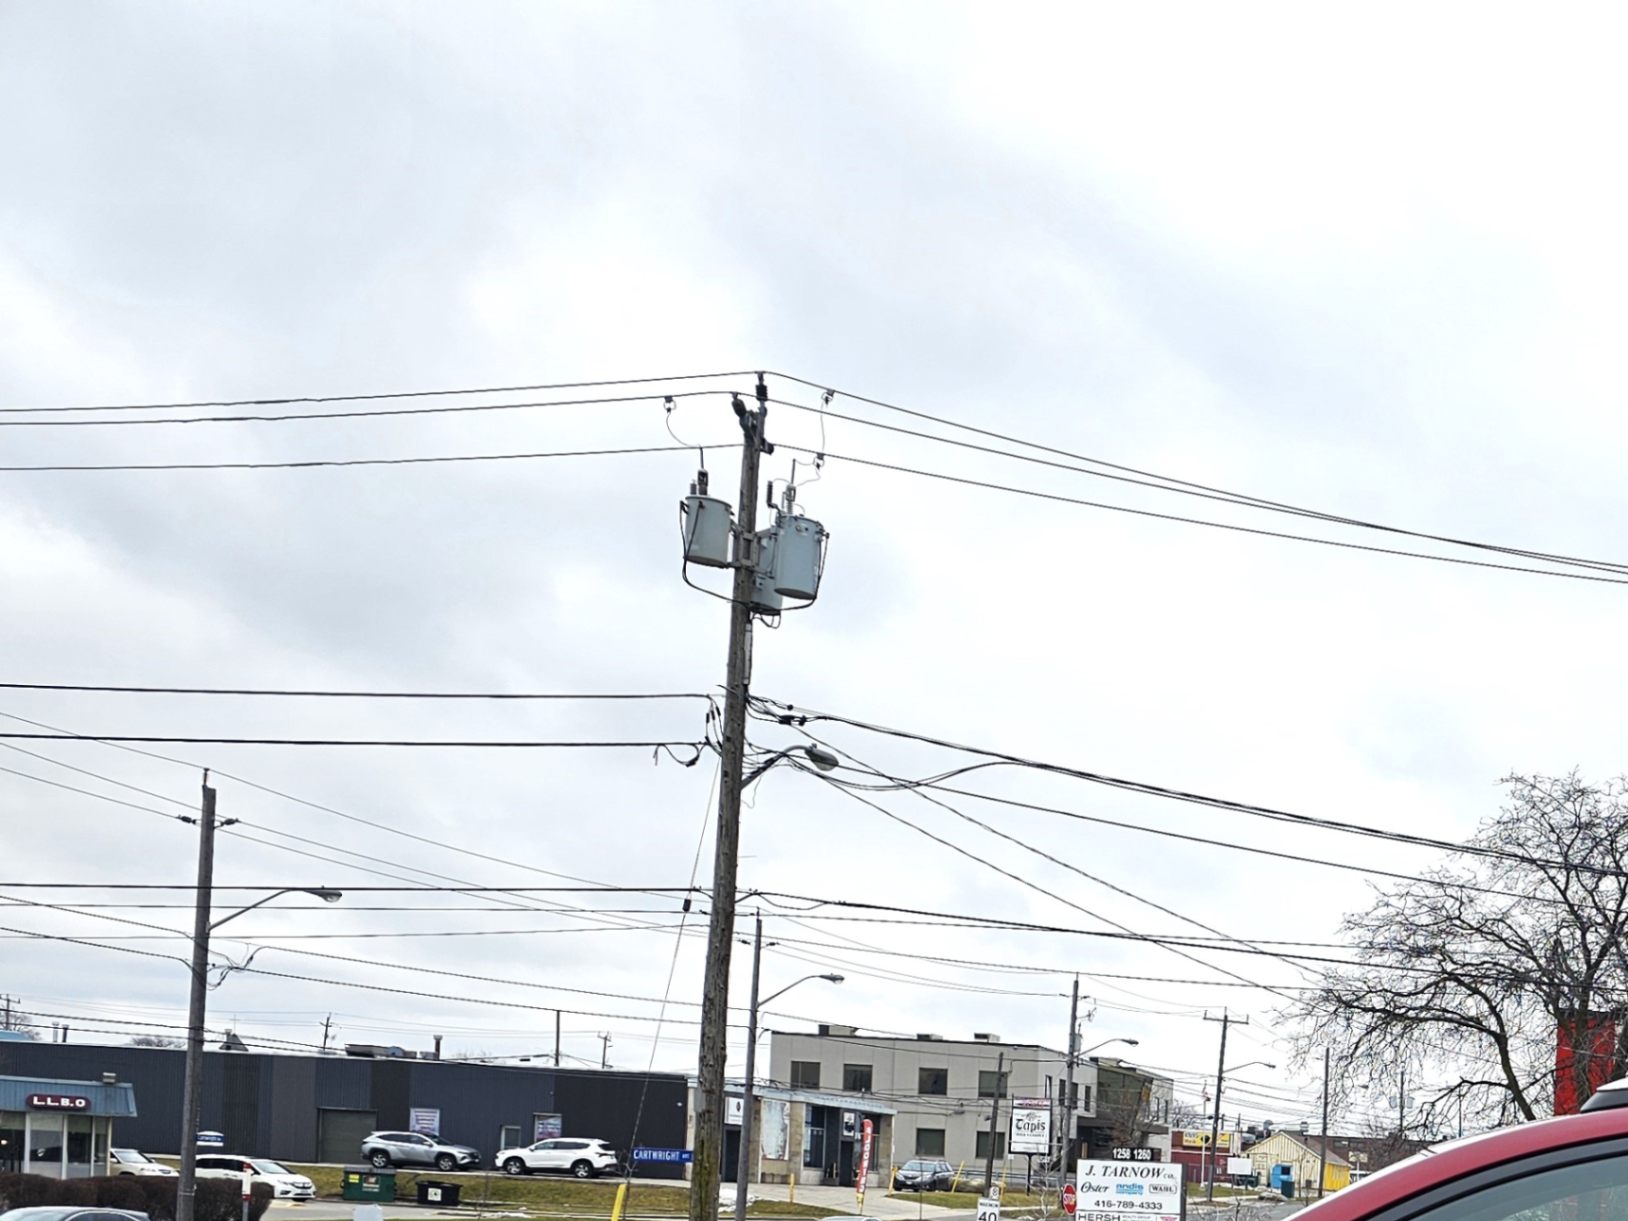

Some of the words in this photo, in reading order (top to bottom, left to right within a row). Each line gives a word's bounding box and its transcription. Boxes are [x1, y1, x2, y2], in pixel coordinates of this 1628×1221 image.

[1015, 1118, 1046, 1133] Tapis
[633, 1149, 680, 1161] CARTWRIGHT
[1112, 1148, 1131, 1159] 1258
[1085, 1165, 1096, 1177] J.
[1102, 1165, 1165, 1179] TARNOW
[1080, 1181, 1109, 1193] Oster
[1094, 1200, 1163, 1210] 416-789-4333
